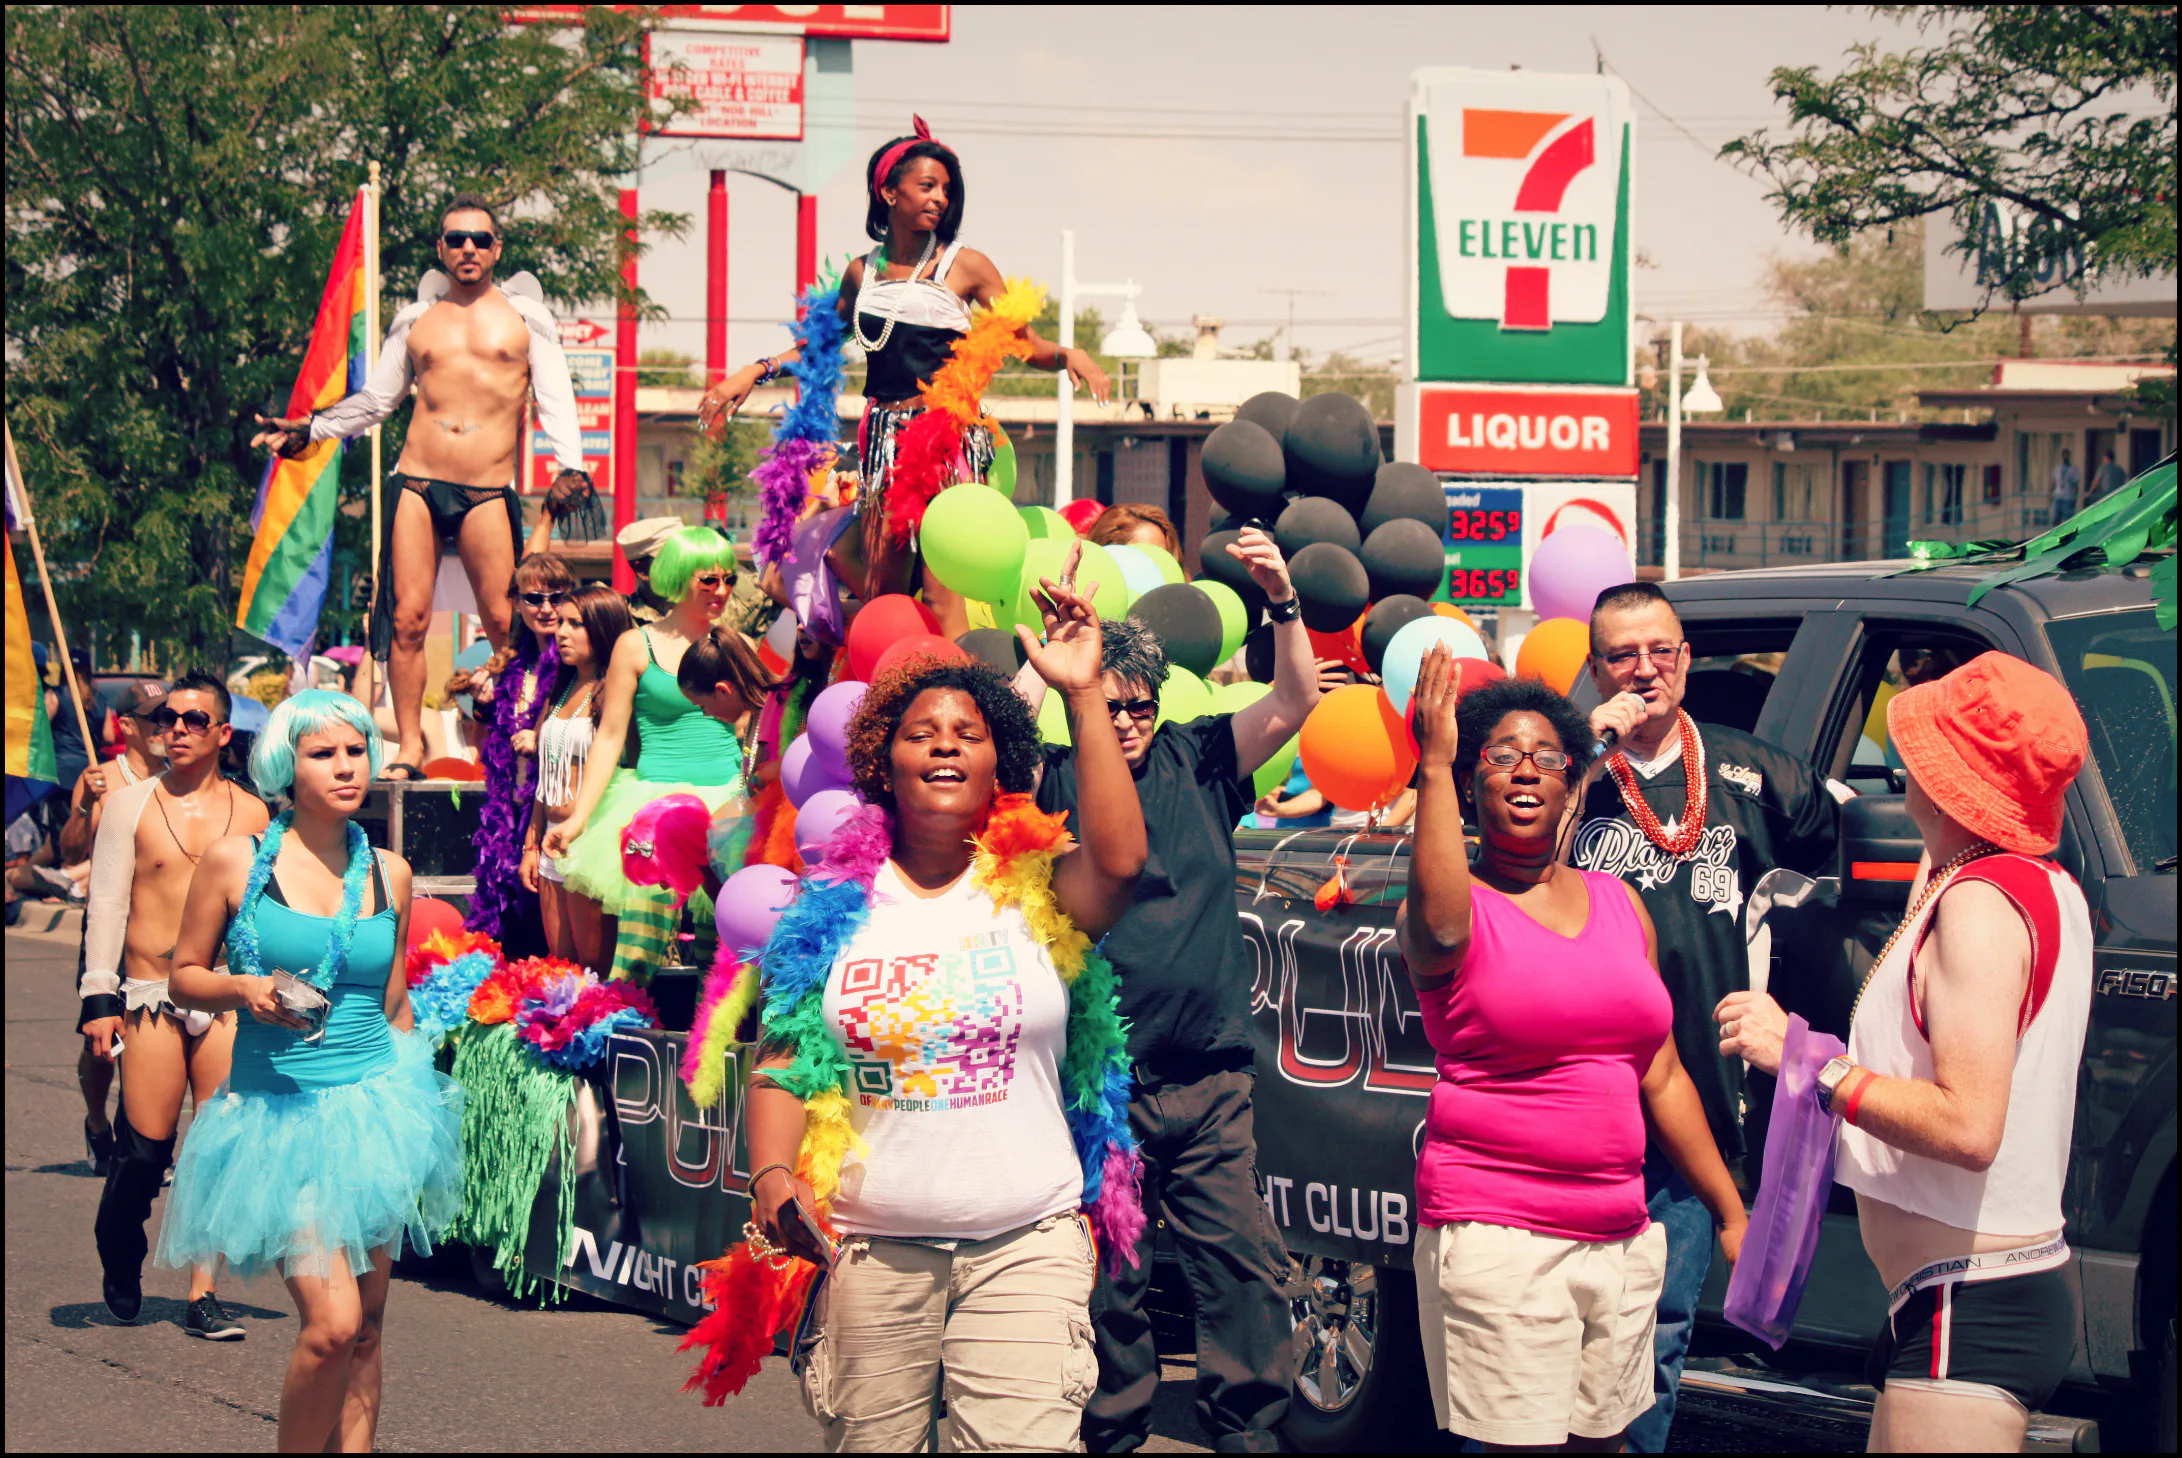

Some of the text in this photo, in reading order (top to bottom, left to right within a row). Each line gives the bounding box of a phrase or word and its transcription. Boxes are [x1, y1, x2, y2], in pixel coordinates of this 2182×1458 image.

[686, 44, 760, 57] COMPETITIVE
[700, 118, 758, 129] LOCATION
[1447, 412, 1610, 451] LIQUOR
[1574, 817, 1737, 884] Playrz
[1690, 862, 1733, 903] 69
[607, 1033, 754, 1199] PUL
[1305, 1182, 1410, 1246] CLUB
[564, 1226, 677, 1300] NIGHT
